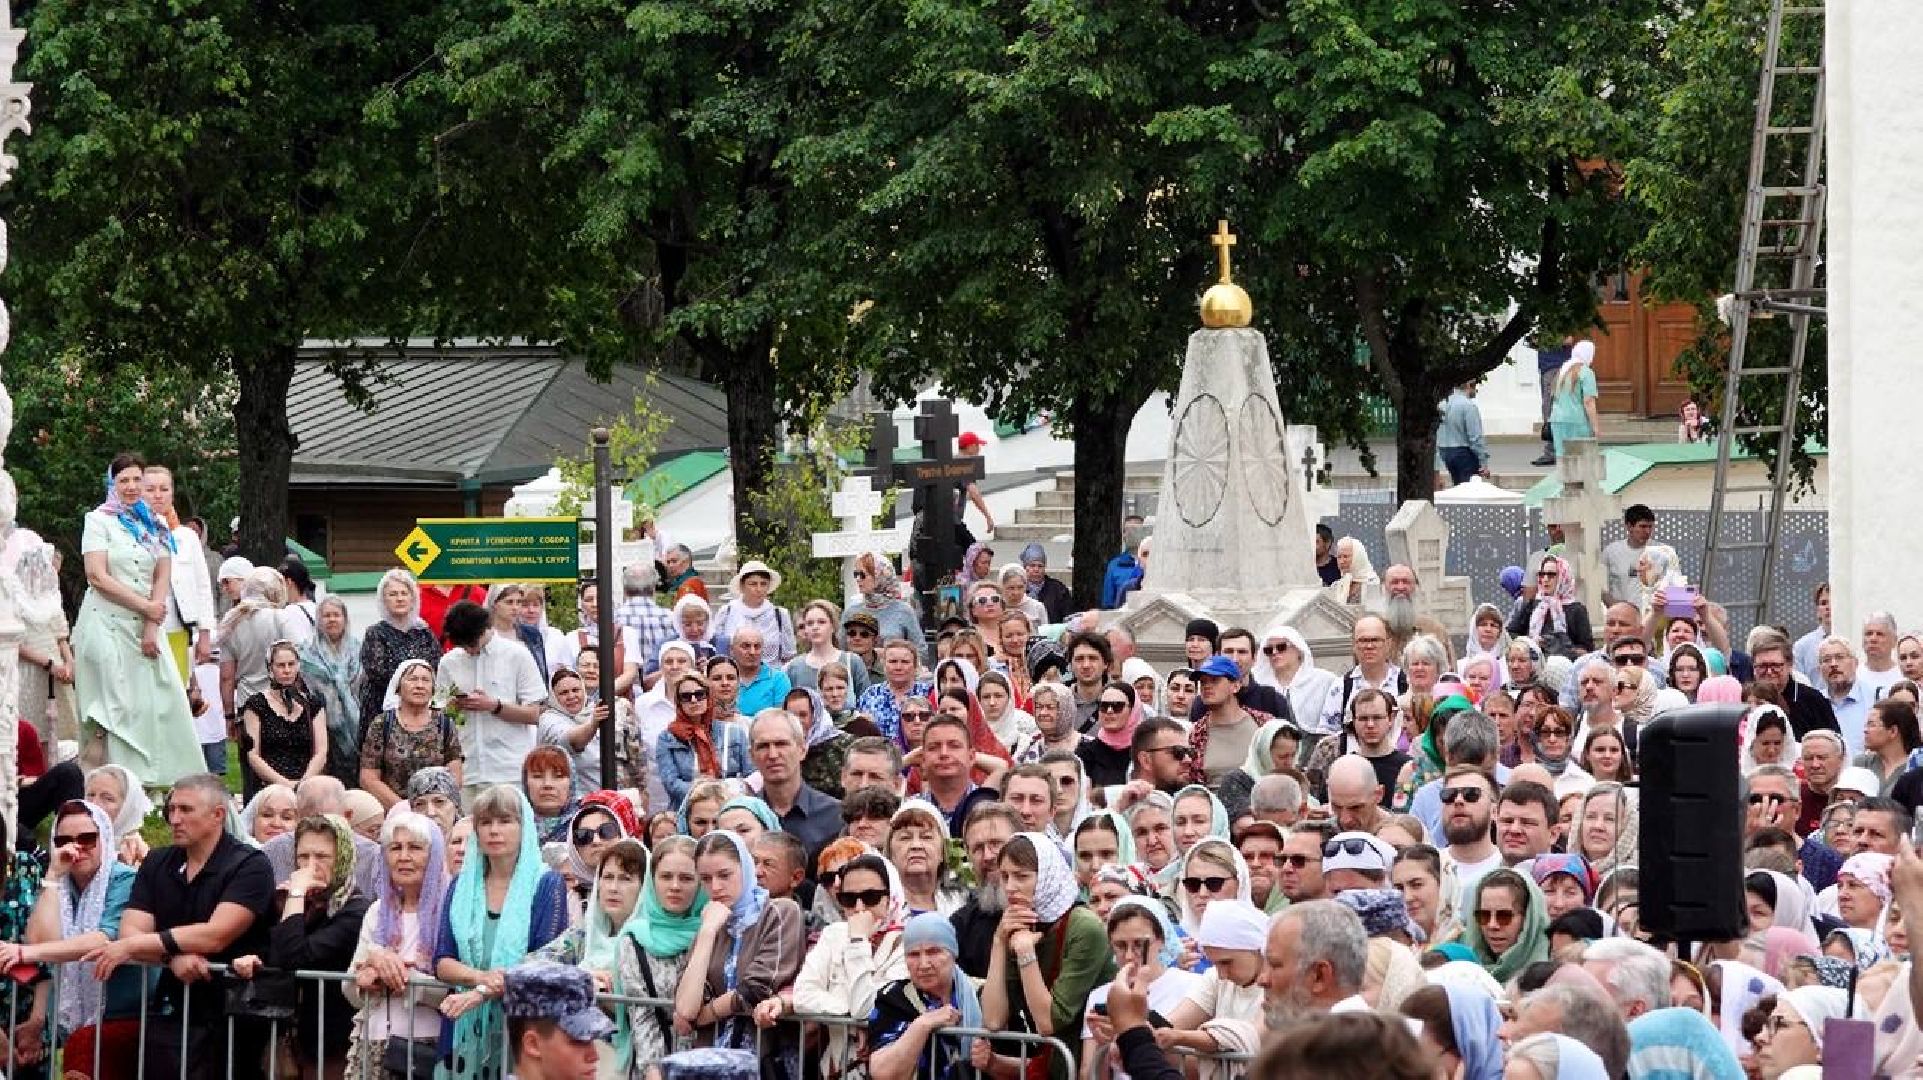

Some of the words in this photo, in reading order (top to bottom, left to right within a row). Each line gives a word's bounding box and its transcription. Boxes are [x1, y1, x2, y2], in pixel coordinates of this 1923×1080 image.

[539, 535, 570, 543] СОБОРА
[451, 556, 492, 565] DORMITION
[545, 556, 570, 564] CRYPT
